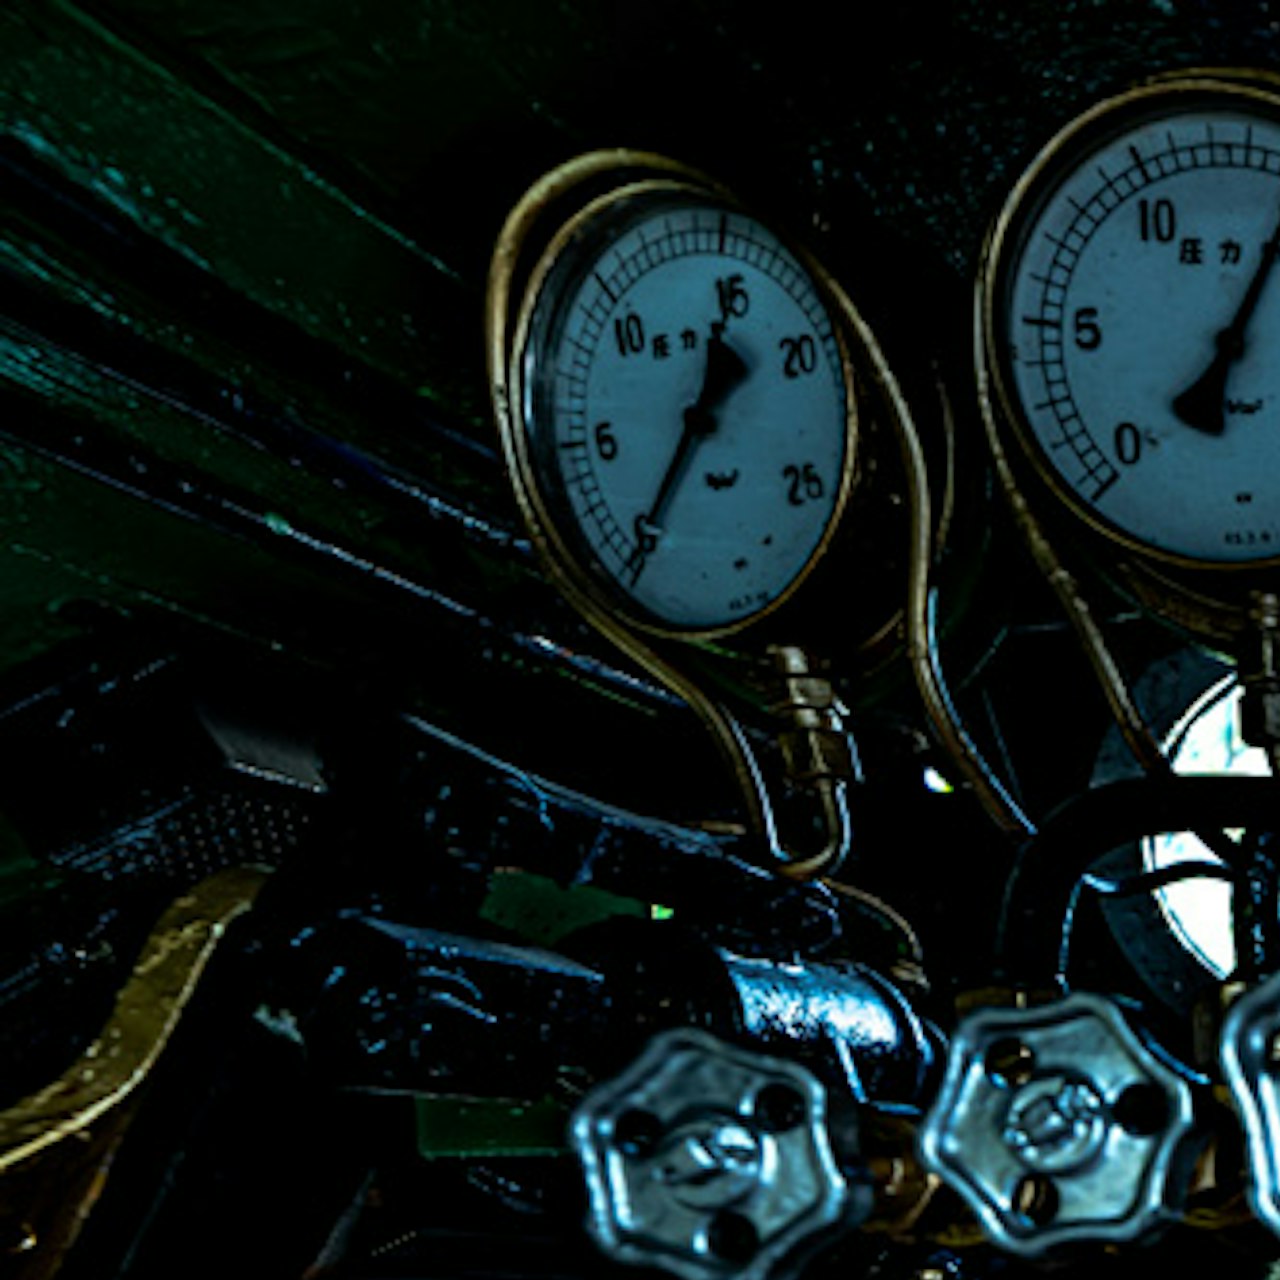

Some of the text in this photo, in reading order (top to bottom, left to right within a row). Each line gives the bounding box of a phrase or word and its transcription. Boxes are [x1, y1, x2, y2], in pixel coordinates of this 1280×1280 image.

[1139, 200, 1175, 242] 10
[715, 275, 748, 317] 15
[615, 314, 644, 356] 10
[1074, 307, 1100, 351] 5
[780, 335, 816, 378] 20
[596, 422, 618, 460] 5
[1113, 422, 1141, 465] 0
[783, 464, 823, 505] 25
